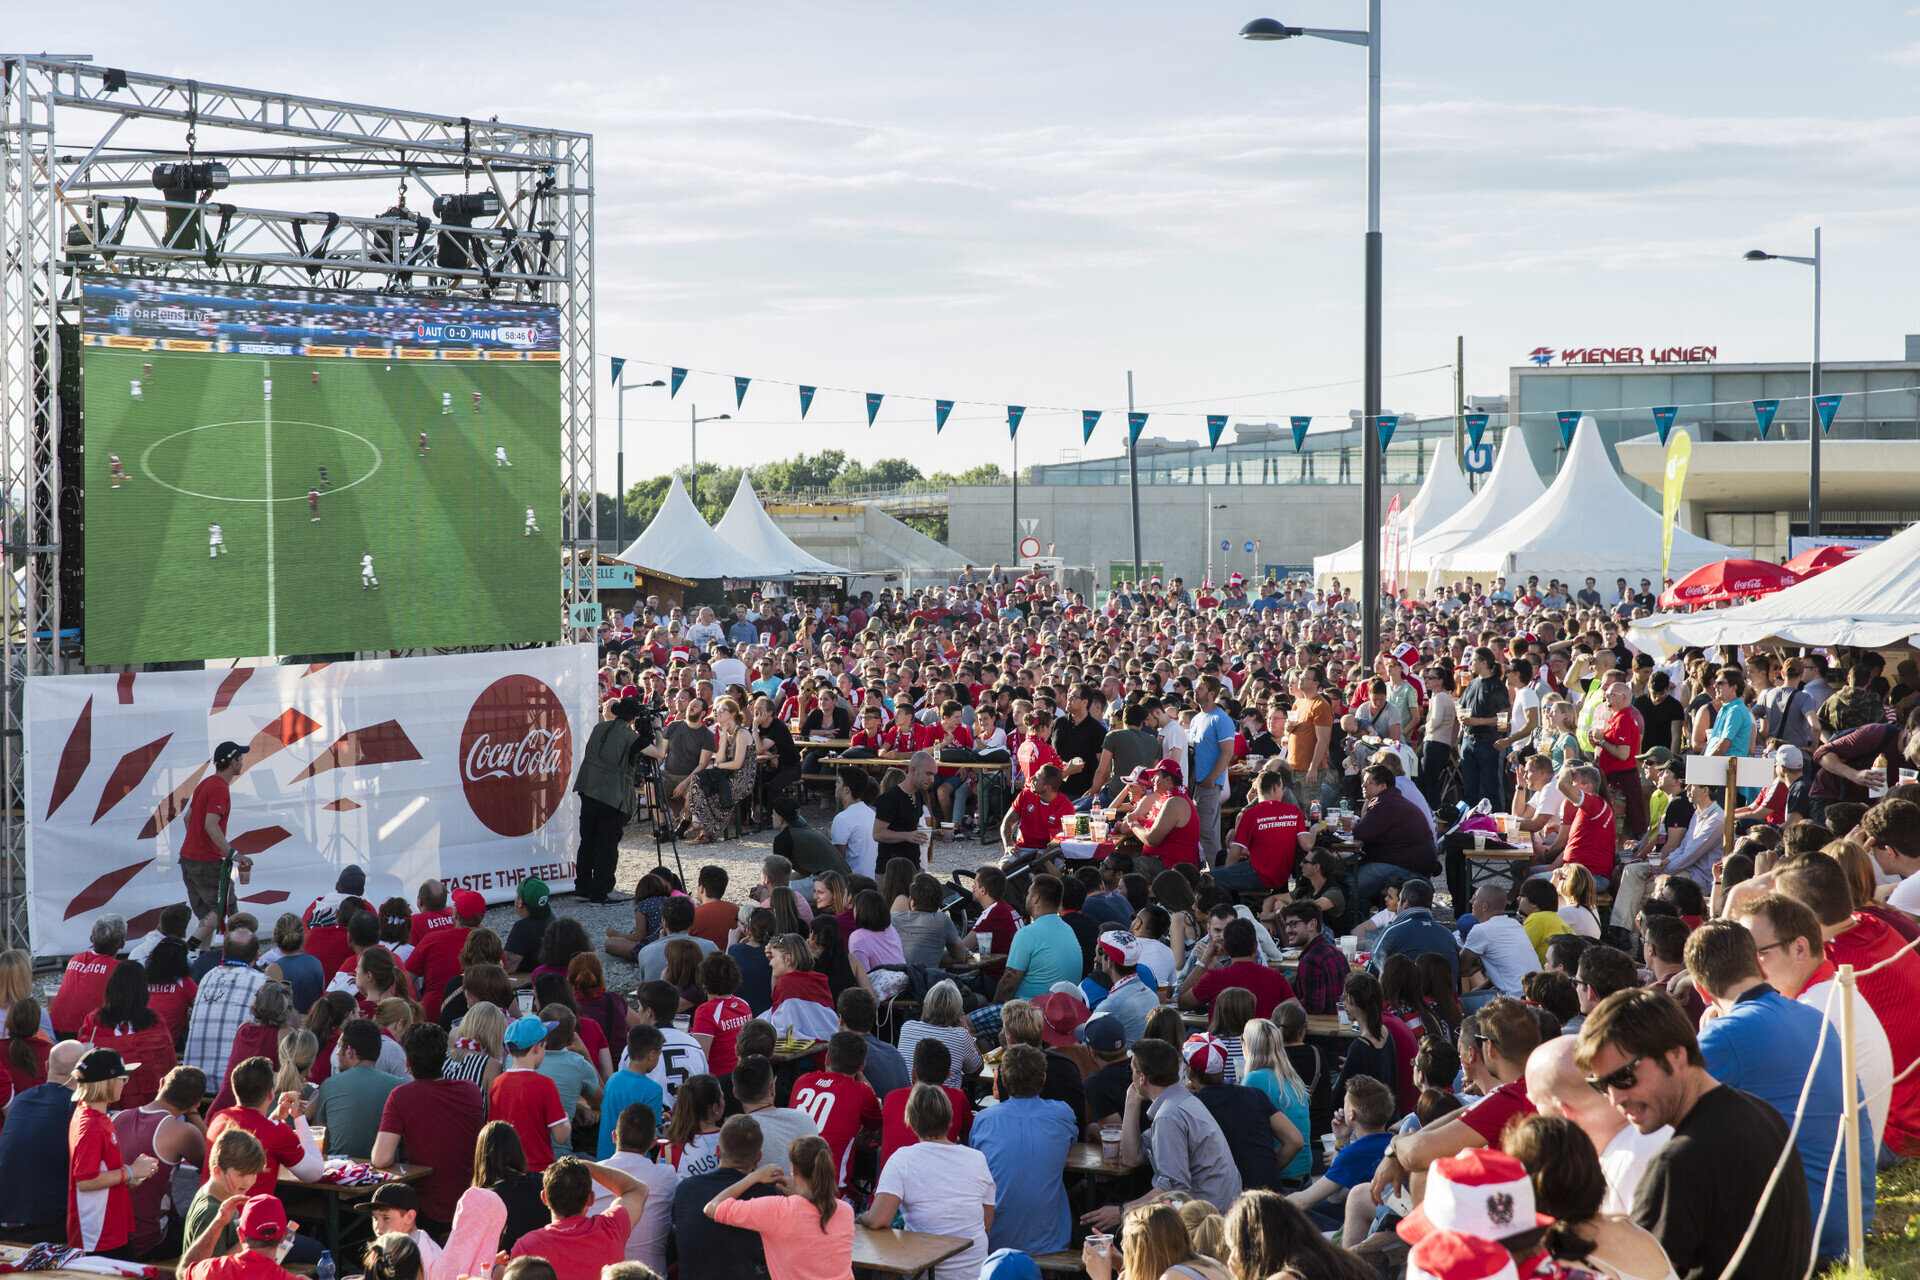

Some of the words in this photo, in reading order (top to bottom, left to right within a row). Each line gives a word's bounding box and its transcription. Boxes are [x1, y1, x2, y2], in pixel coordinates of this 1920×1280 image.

[134, 309, 157, 319] ORF
[160, 309, 183, 320] eins
[425, 327, 443, 337] AUT
[449, 328, 467, 338] 0-0
[472, 329, 491, 340] HUN
[1561, 347, 1645, 363] WIENER
[1650, 345, 1717, 362] LINIEN
[1468, 449, 1486, 469] U
[583, 607, 597, 623] WC
[465, 727, 567, 782] Coca-Cola
[440, 872, 493, 894] TASTE
[495, 868, 526, 888] THE
[661, 1048, 690, 1099] 5
